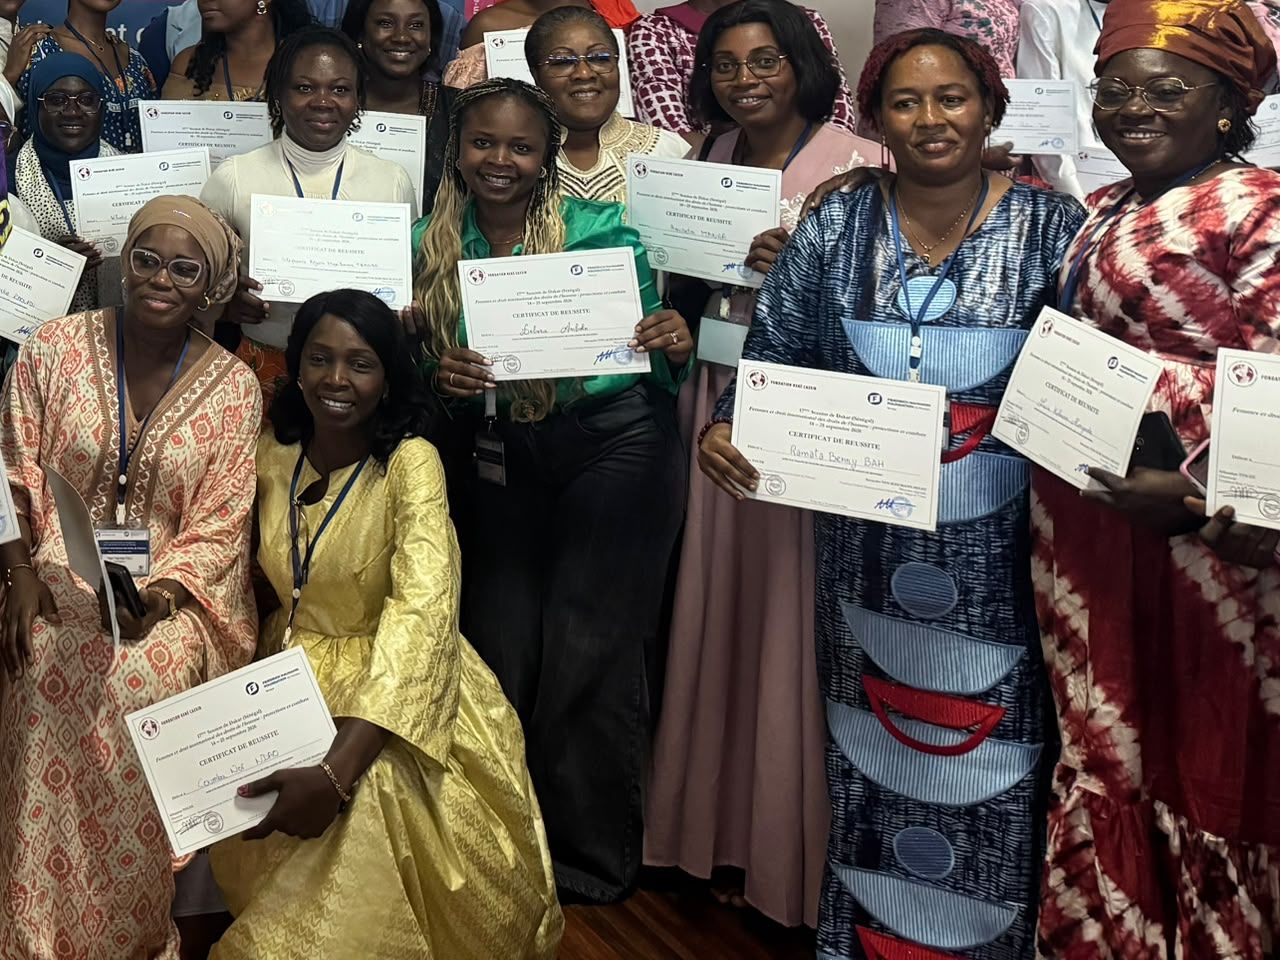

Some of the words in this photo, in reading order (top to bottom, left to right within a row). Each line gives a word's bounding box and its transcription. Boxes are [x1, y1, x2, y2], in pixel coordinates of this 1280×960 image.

[665, 210, 695, 220] CERTIFICAT
[706, 216, 732, 225] REUSSITE
[788, 430, 831, 442] CERTIFICAT
[844, 439, 880, 450] REUSSITE
[863, 456, 884, 468] BAH
[198, 746, 238, 767] CERTIFICAT
[237, 742, 248, 751] DE
[247, 729, 280, 747] REUSSITE
